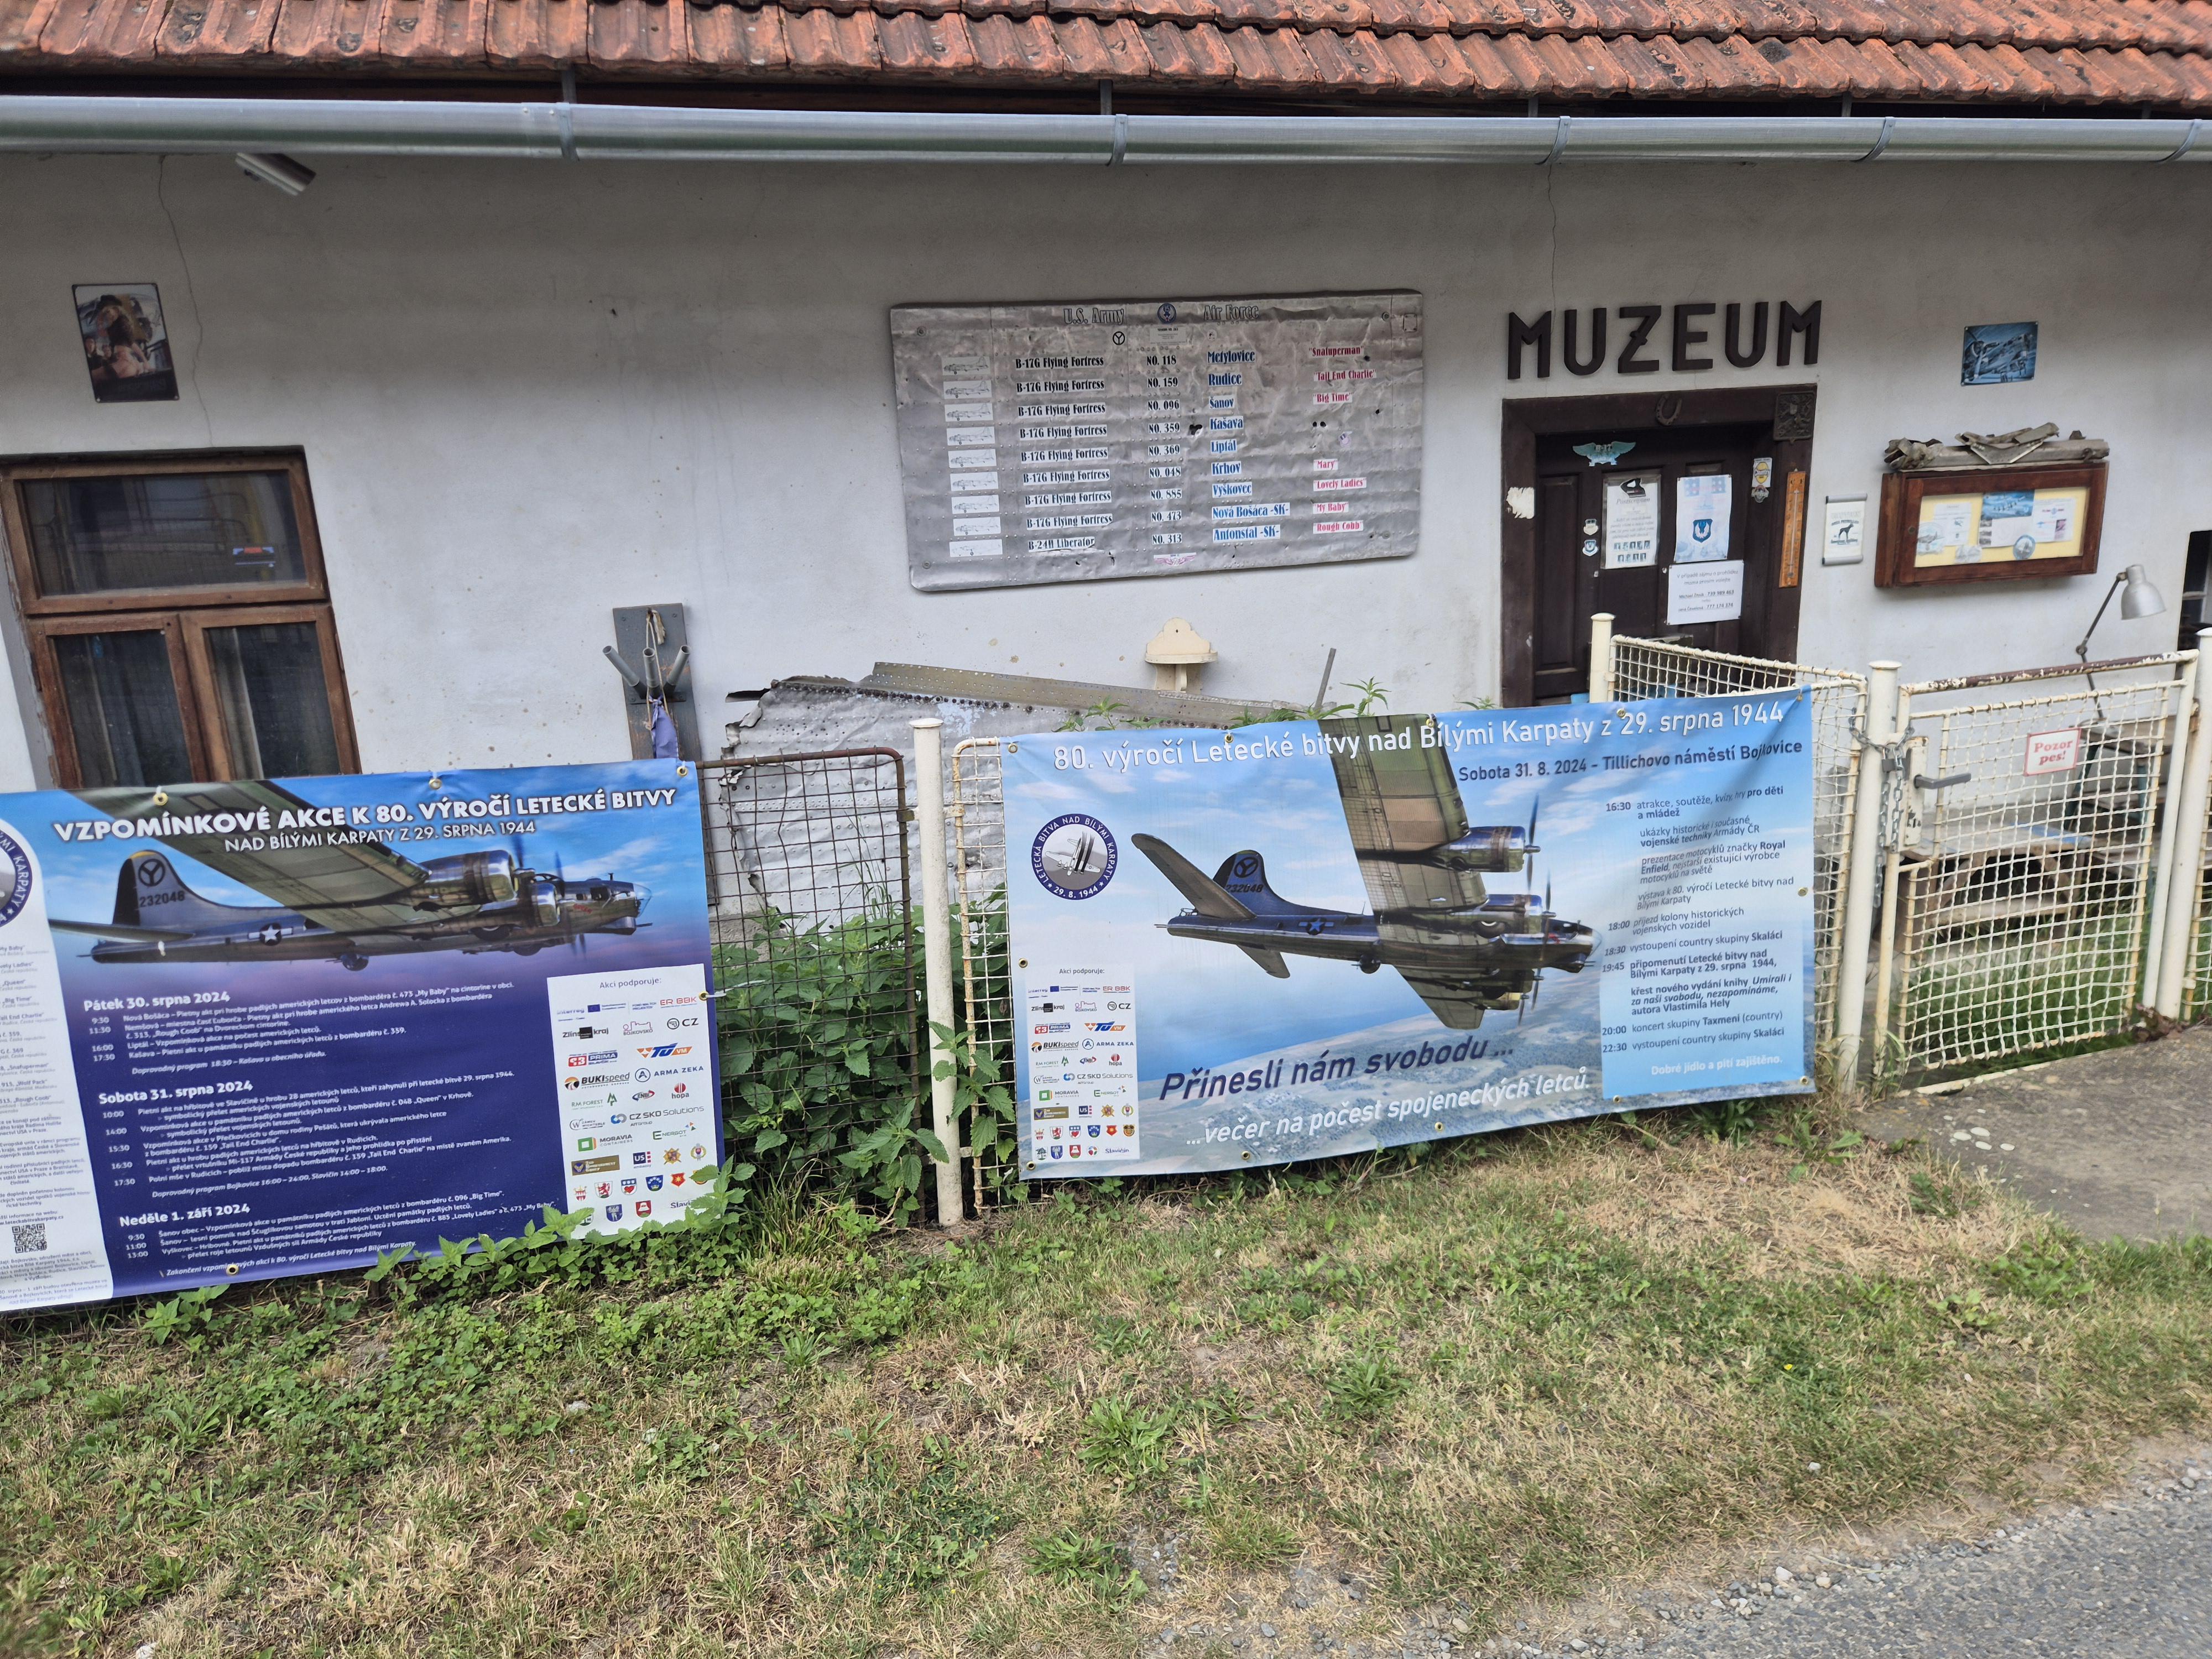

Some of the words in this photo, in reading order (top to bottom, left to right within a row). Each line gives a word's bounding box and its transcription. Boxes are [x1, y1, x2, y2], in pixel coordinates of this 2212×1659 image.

[1063, 308, 1088, 324] U.S.
[1092, 307, 1124, 325] Army
[1204, 305, 1222, 321] Air
[1226, 305, 1260, 320] Force
[1507, 300, 1822, 380] MUZEUM
[1016, 358, 1040, 368] B-17G
[1044, 357, 1068, 369] Flying
[1071, 356, 1104, 367] Fortress
[1147, 356, 1159, 366] NO.
[1162, 355, 1176, 365] 118
[1208, 351, 1255, 364] Metylovice
[1208, 373, 1241, 385] Rudice
[1332, 371, 1345, 380] End
[1148, 378, 1160, 388] NO.
[1164, 377, 1178, 387] 159
[1210, 397, 1234, 409] Šanov
[1210, 417, 1243, 430] Kašava
[1211, 440, 1236, 453] Liptál
[1212, 463, 1240, 475] Krhov
[1151, 491, 1162, 499] NO.
[1166, 489, 1181, 498] 885
[1213, 484, 1251, 497] Vyškovec
[1213, 507, 1234, 519] Nová
[1237, 506, 1267, 517] Bošáca
[1057, 538, 1094, 548] Liberator
[1152, 535, 1164, 544] NO.
[1168, 534, 1181, 543] 313
[1053, 745, 1094, 770] 80.
[1103, 738, 1184, 774] výročí
[1192, 732, 1293, 764] Letecké
[1301, 733, 1359, 759] bitvy
[1368, 725, 1411, 753] nad
[1421, 720, 1494, 752] Bílými
[1502, 716, 1594, 745] Karpaty
[1601, 718, 1611, 736] z
[1619, 711, 1653, 737] 29.
[1660, 709, 1724, 735] srpna
[1731, 701, 1785, 727] 1944
[2034, 740, 2073, 753] Pozor
[1458, 765, 1511, 781] Sobota
[1514, 763, 1533, 778] 31.
[1537, 761, 1550, 776] 8.
[1554, 759, 1587, 775] 2024
[1601, 753, 1671, 770] Tillichovo
[1674, 745, 1736, 765] náměstí
[1740, 741, 1803, 761] Bojkovice
[2038, 750, 2066, 765] pes!
[1606, 801, 1631, 811] 16:30
[1747, 789, 1762, 799] pro
[1765, 786, 1783, 796] děti
[53, 805, 271, 843] VZPOMÍNKOVÉ
[277, 806, 347, 830] AKCE
[353, 807, 371, 824] K
[376, 805, 414, 823] 80.
[419, 794, 510, 820] VÝROČÍ
[517, 788, 606, 815] LETECKÉ
[611, 788, 676, 809] BITVY
[1646, 808, 1680, 819] mládež
[1062, 816, 1080, 825] NAD
[1038, 822, 1060, 842] BITVA
[1084, 818, 1110, 839] BÍLÝMI
[224, 837, 266, 853] NAD
[269, 831, 324, 851] BÍLÝMI
[326, 830, 395, 846] KARPATY
[399, 828, 410, 841] Z
[414, 826, 440, 839] 29.
[443, 823, 495, 838] SRPNA
[499, 820, 536, 834] 1944
[1034, 845, 1048, 883] LETECKÁ
[1103, 842, 1115, 880] KARPATY
[13, 854, 29, 909] KARPATY
[1053, 886, 1065, 896] 29.
[1079, 885, 1098, 898] 1944
[138, 890, 185, 907] 232048
[1751, 930, 1783, 941] Skaláci
[619, 978, 661, 988] podporuje:
[84, 998, 124, 1011] Pátek
[127, 998, 149, 1008] 30.
[153, 995, 190, 1010] srpna
[194, 992, 231, 1003] 2024
[1601, 1025, 1626, 1036] 20:00
[1632, 1021, 1665, 1033] koncert
[1667, 1018, 1700, 1030] skupiny
[1703, 1014, 1740, 1025] Taxmeni
[1743, 1010, 1783, 1023] (country)
[1603, 1042, 1627, 1053] 22:30
[1159, 1058, 1284, 1101] Přinesli
[1292, 1050, 1355, 1084] nám
[1364, 1035, 1490, 1074] svobodu
[1651, 1064, 1681, 1076] Dobré
[1684, 1061, 1705, 1073] jídlo
[1717, 1056, 1734, 1070] pití
[1735, 1055, 1783, 1067] zajištěno.
[581, 1072, 630, 1084] BUKIspeed
[98, 1090, 148, 1104] Sobota
[150, 1089, 173, 1100] 31.
[176, 1087, 214, 1099] srpna
[217, 1080, 253, 1093] 2024
[663, 1106, 704, 1116] Solutions
[1186, 1115, 1270, 1146] ...večer
[1276, 1118, 1303, 1136] na
[1308, 1104, 1381, 1136] počest
[1387, 1076, 1530, 1123] spojeneckých
[1534, 1066, 1590, 1098] letců.
[599, 1134, 632, 1142] MORAVIA
[119, 1211, 168, 1227] Neděle
[172, 1211, 185, 1220] 1.
[187, 1206, 212, 1219] září
[215, 1203, 251, 1215] 2024
